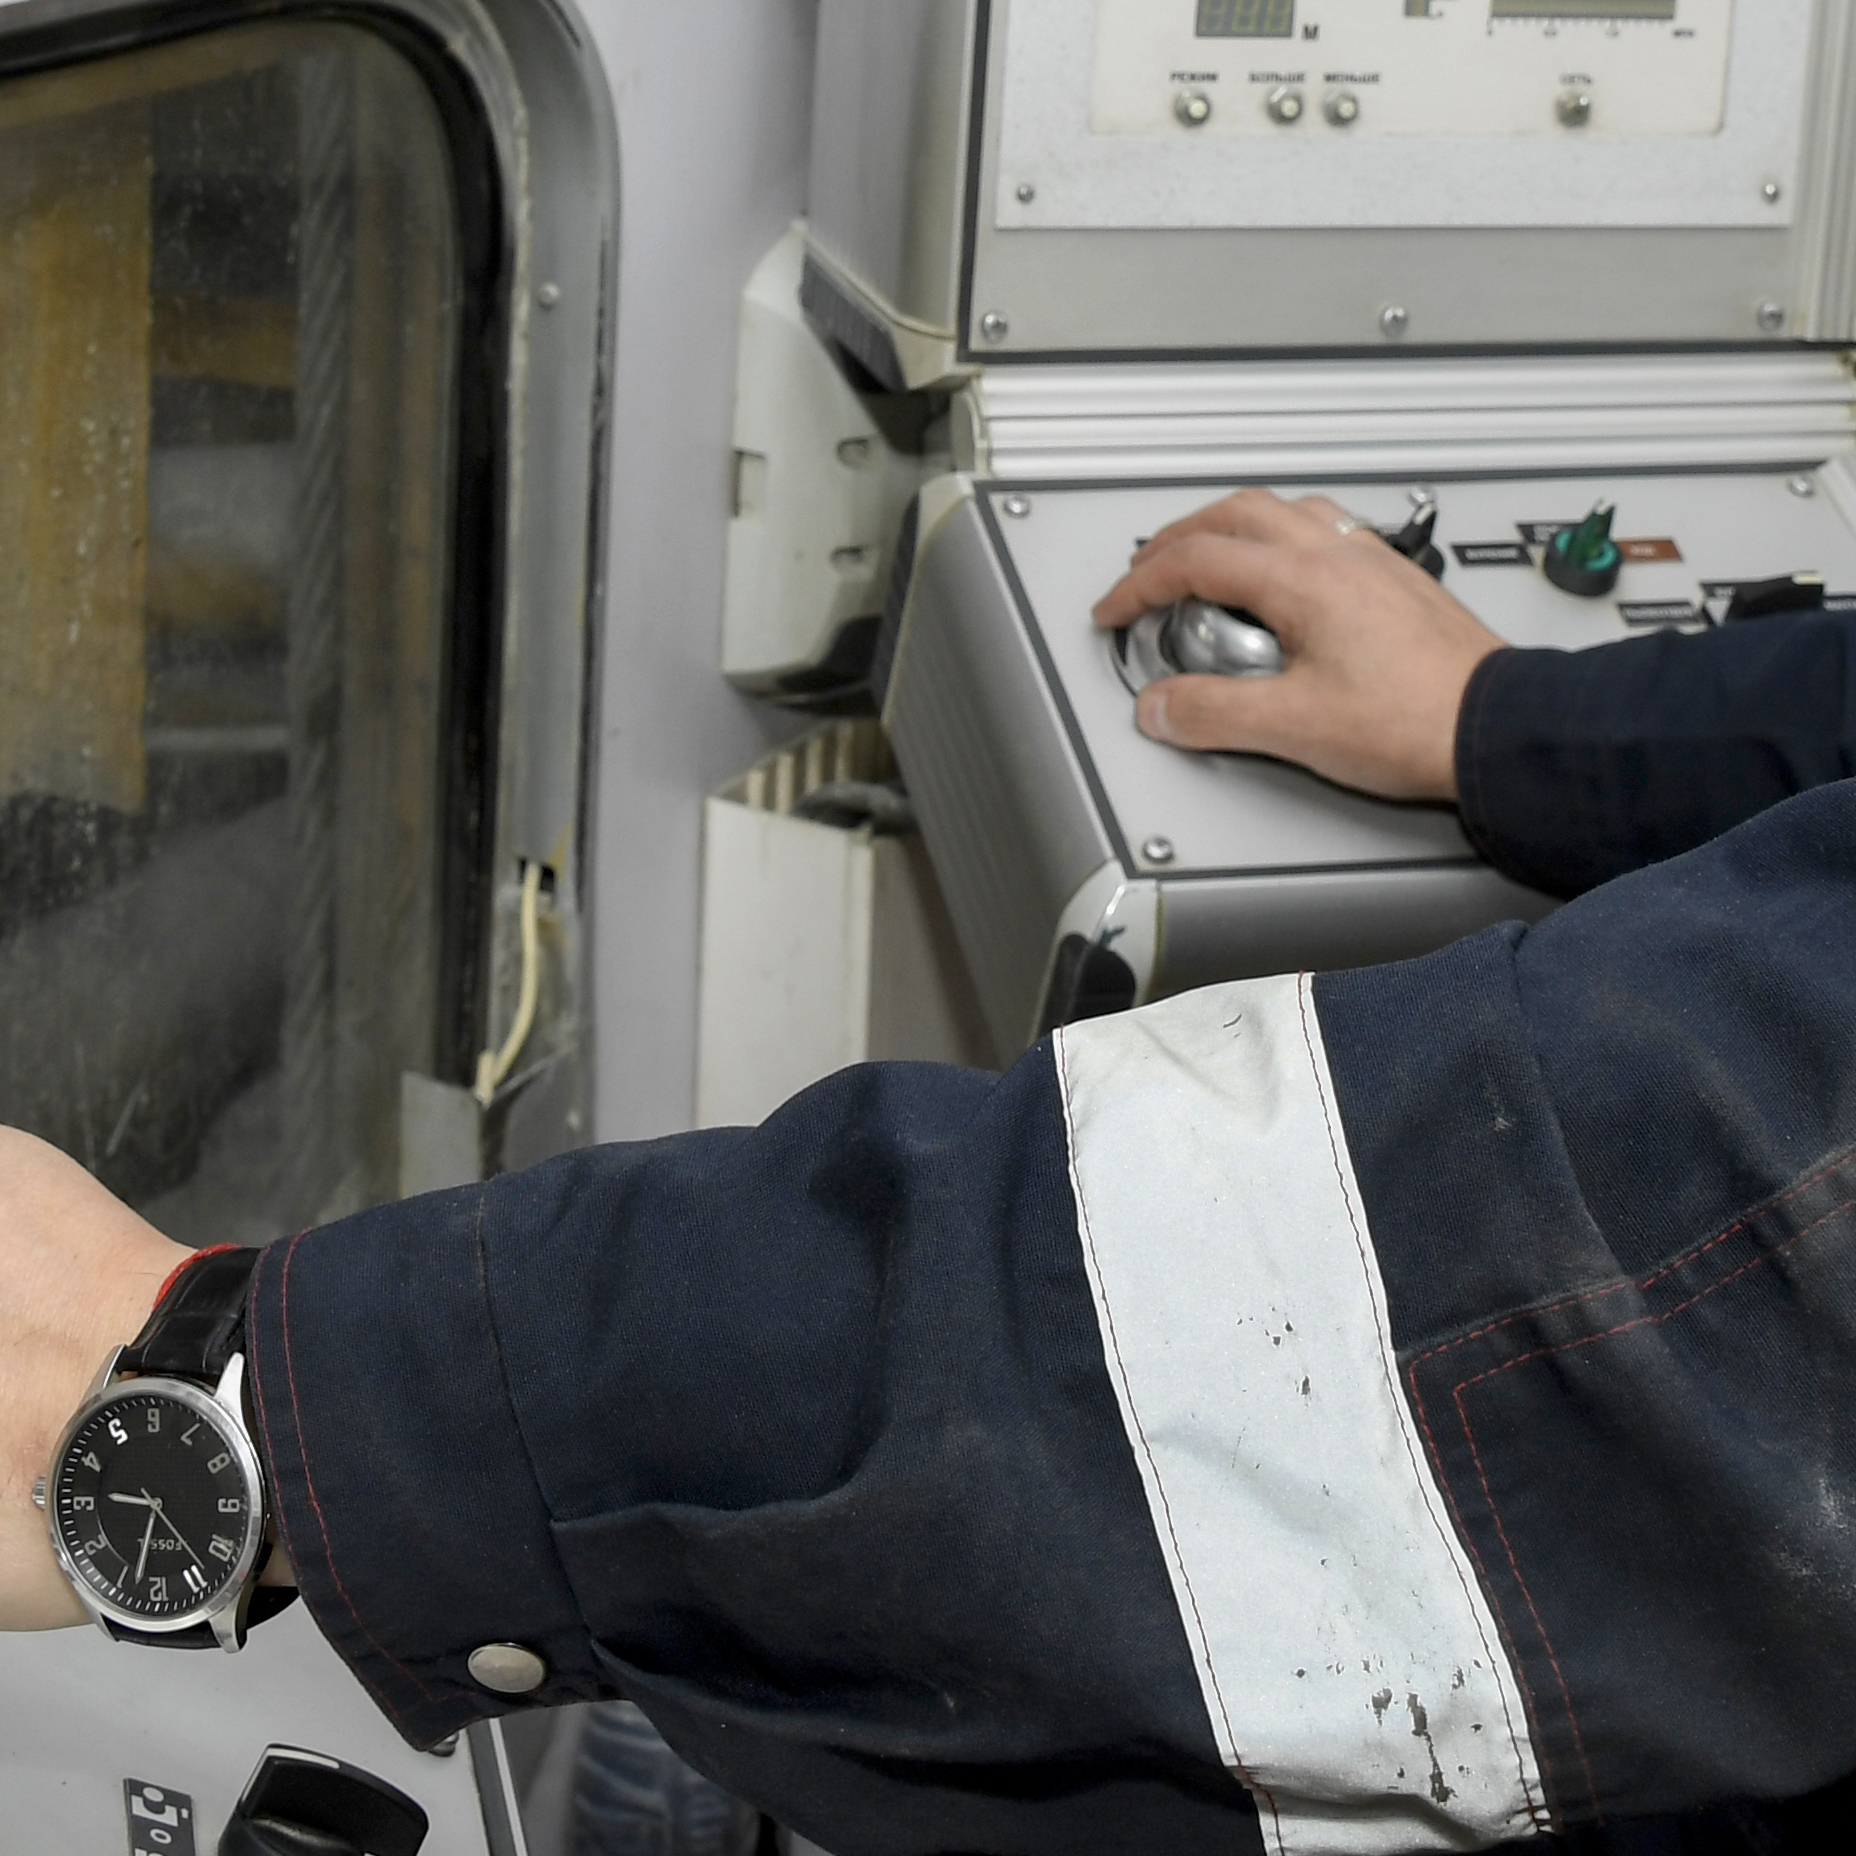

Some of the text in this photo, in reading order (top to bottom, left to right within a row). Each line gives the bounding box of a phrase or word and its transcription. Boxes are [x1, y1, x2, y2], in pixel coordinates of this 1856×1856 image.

[106, 1417, 128, 1446] 5
[146, 1407, 160, 1433] 6
[180, 1422, 201, 1446] 7
[80, 1451, 102, 1473] 4
[206, 1451, 230, 1475] 8
[73, 1494, 95, 1512] 3
[217, 1497, 241, 1514] 9
[83, 1533, 106, 1555] 2
[136, 1537, 182, 1552] FOSSL
[208, 1533, 234, 1562] 10
[115, 1565, 129, 1589] 1
[147, 1575, 170, 1602] 12
[181, 1563, 209, 1593] 11
